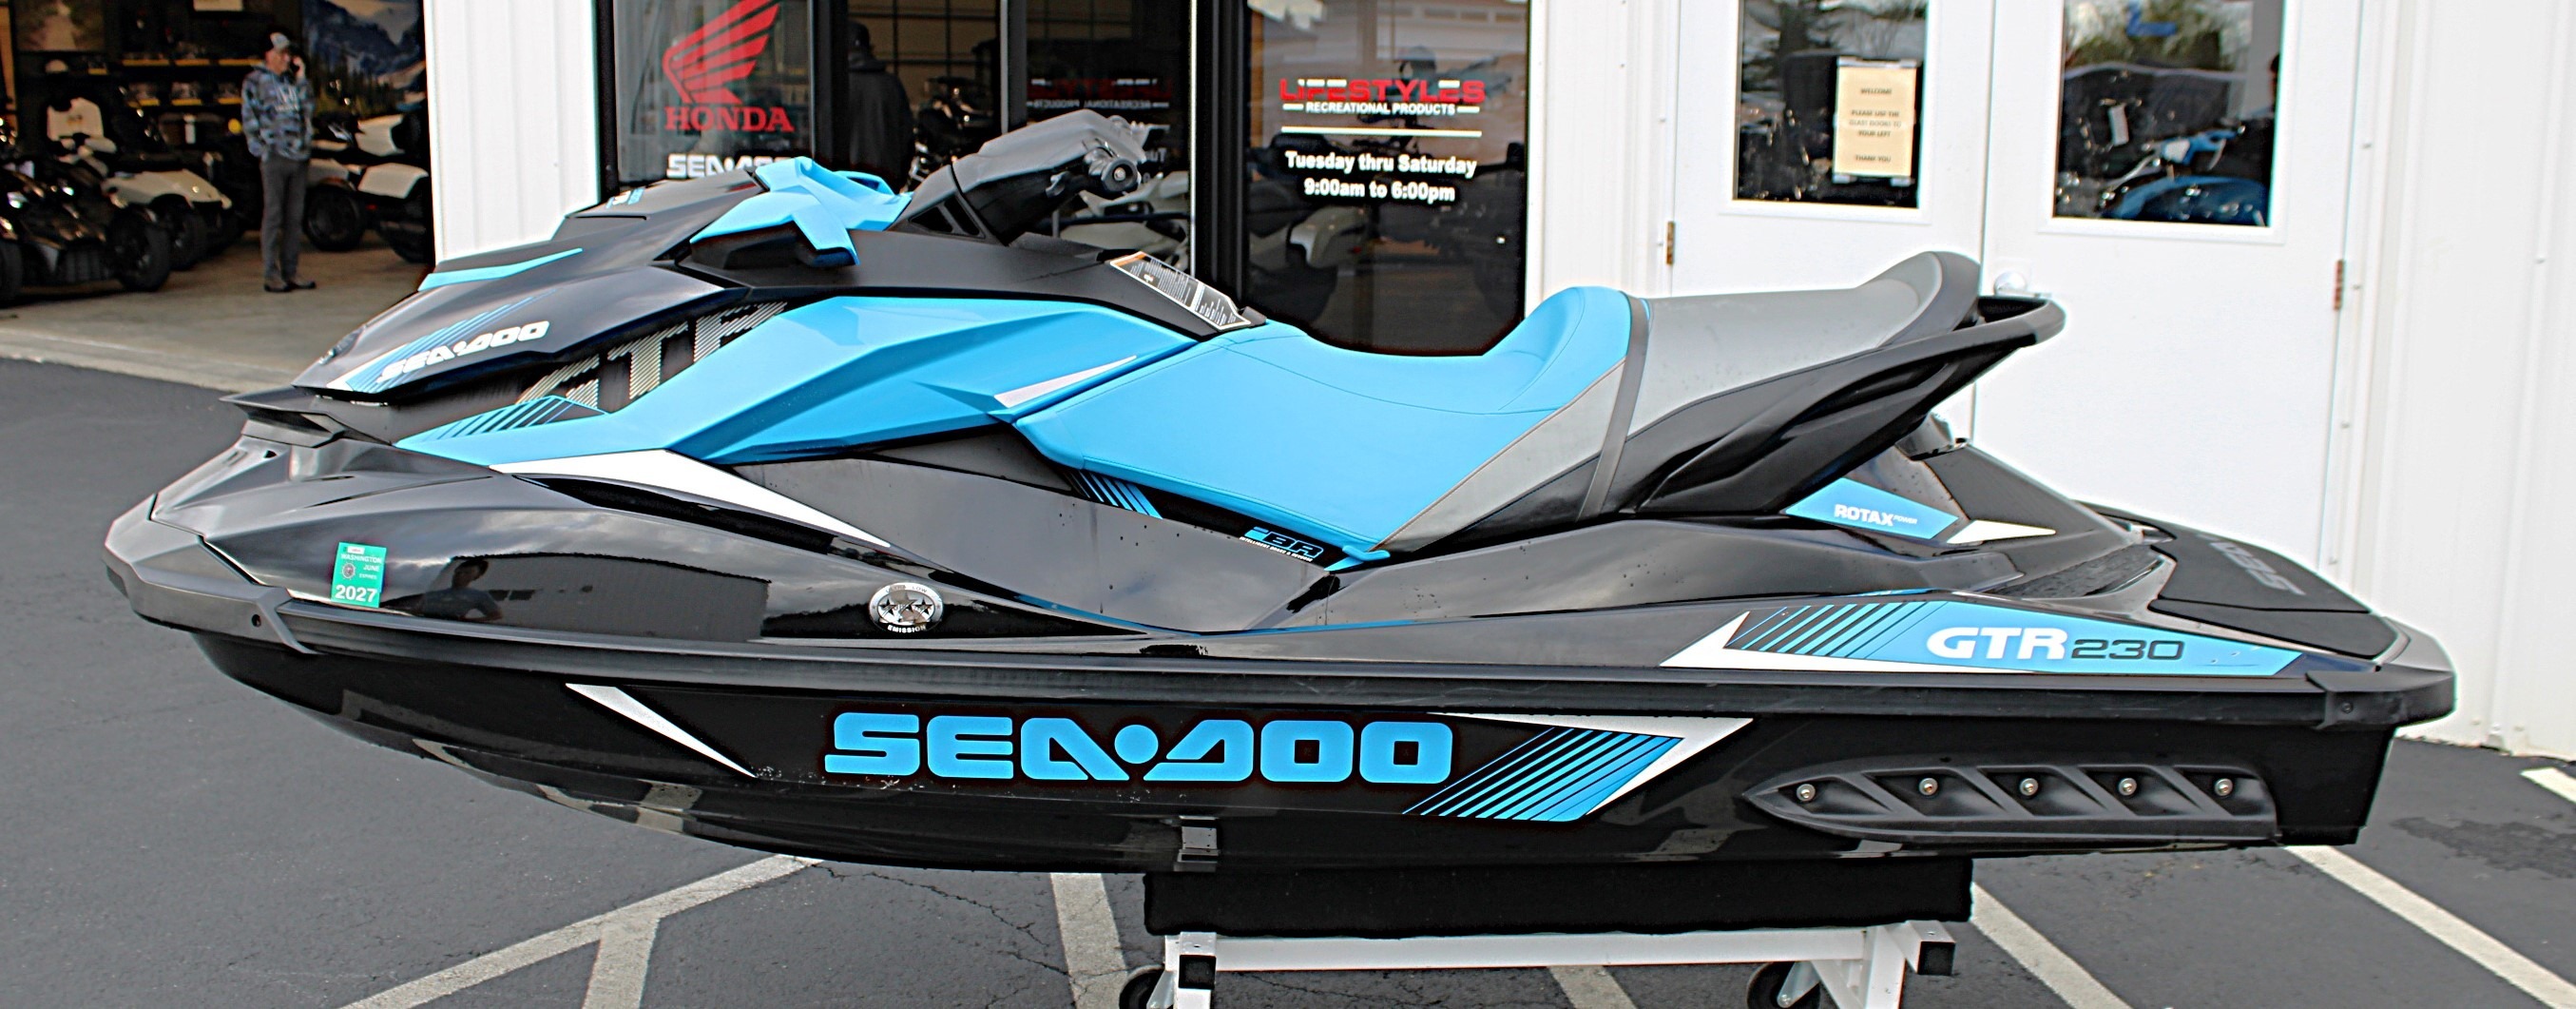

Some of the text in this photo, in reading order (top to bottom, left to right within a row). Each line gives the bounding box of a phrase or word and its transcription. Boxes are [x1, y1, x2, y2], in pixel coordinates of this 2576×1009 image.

[1279, 79, 1486, 104] LIFESTYLES
[664, 106, 795, 132] HONDA
[1305, 102, 1455, 115] RECREATIONAL PRODUCTS
[1285, 150, 1477, 179] Tuesday thru Saturday
[1304, 178, 1455, 204] 9:00am to 6:00pm
[1834, 503, 1917, 527] ROTAX POWER
[340, 553, 381, 563] WASHINGTON
[335, 584, 378, 603] 2027
[887, 624, 927, 633] EMISSION
[1926, 627, 2184, 660] GTR 230
